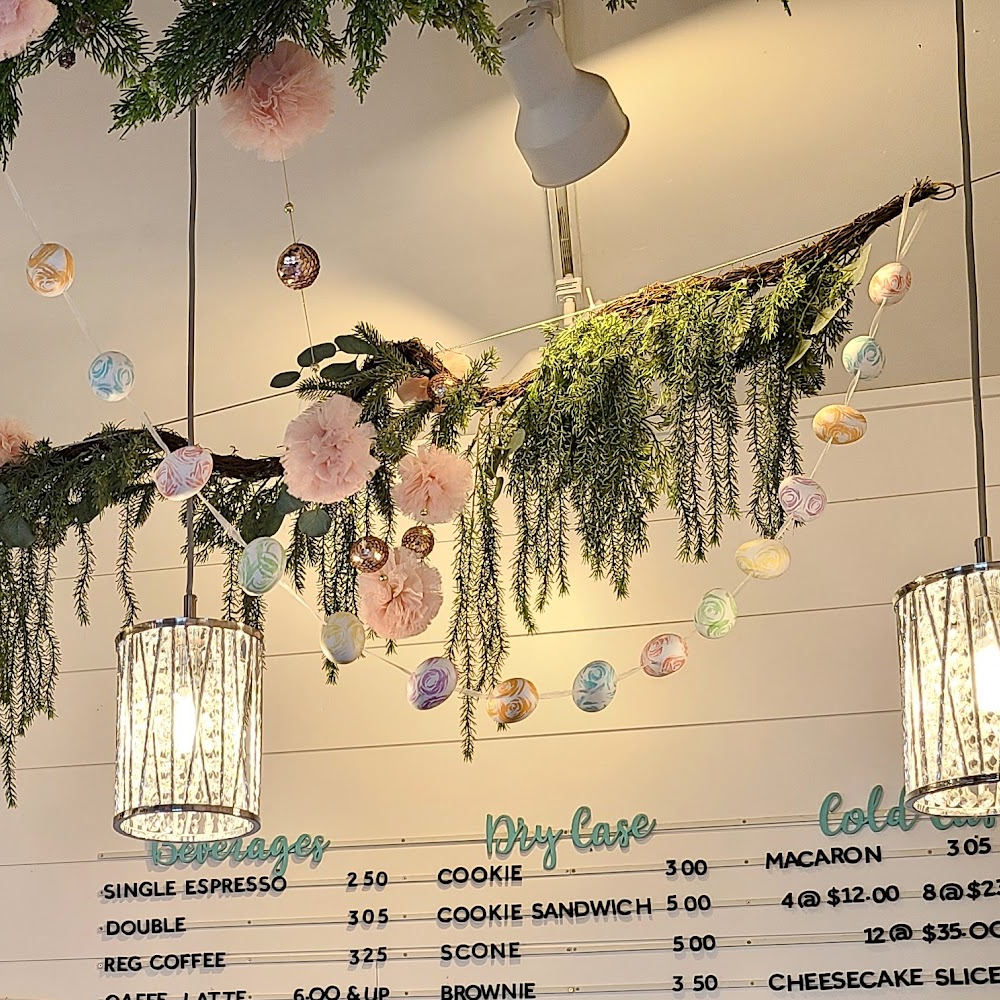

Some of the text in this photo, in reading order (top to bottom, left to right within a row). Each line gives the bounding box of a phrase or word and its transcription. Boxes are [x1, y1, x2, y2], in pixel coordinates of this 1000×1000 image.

[819, 785, 918, 836] Cold
[486, 806, 656, 870] Dry Case
[152, 834, 331, 876] Beverages
[766, 846, 881, 869] MACARON
[438, 865, 522, 884] COOKIE
[103, 881, 176, 899] SINGLE
[186, 876, 286, 895] ESPRESSO
[438, 904, 522, 922] COOKIE
[532, 898, 651, 919] SANDWICH
[107, 917, 186, 935] DOUBLE
[105, 956, 141, 972] REG
[150, 953, 225, 970] COFFEE
[442, 942, 521, 960] SCONE
[769, 967, 1000, 991] CHEESECAKE SLICE
[442, 983, 535, 1000] BROWNIE
